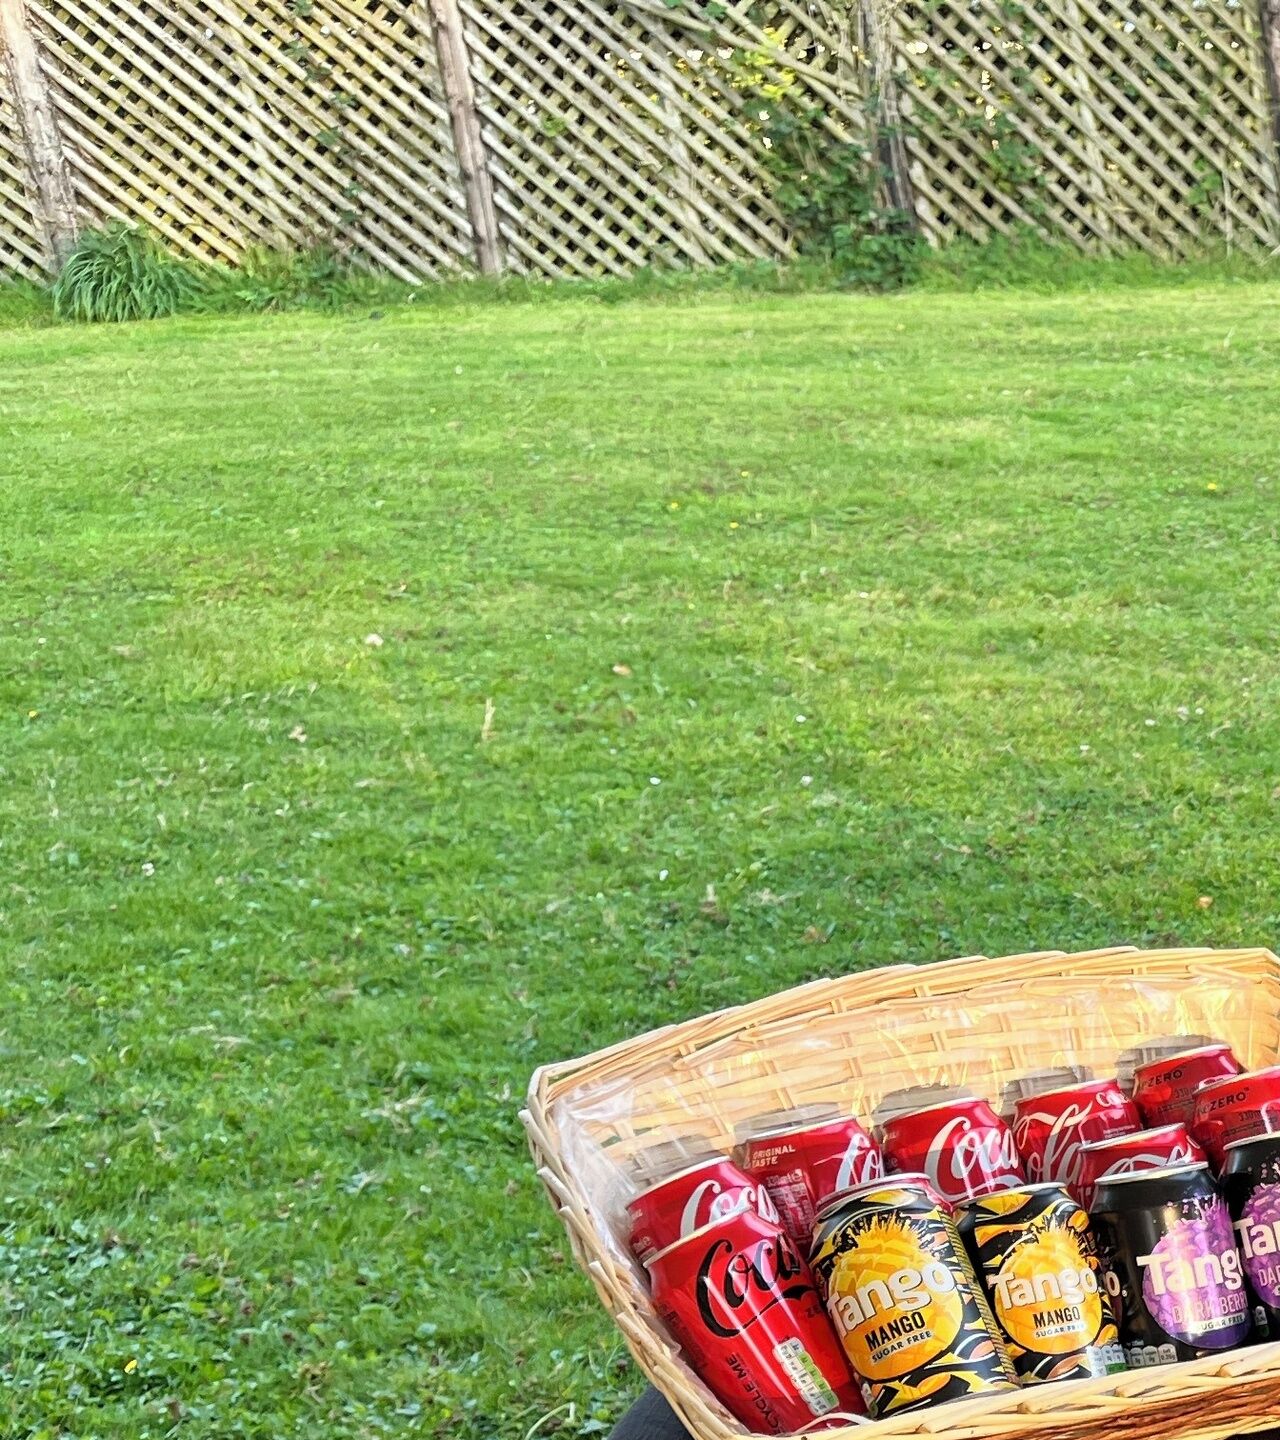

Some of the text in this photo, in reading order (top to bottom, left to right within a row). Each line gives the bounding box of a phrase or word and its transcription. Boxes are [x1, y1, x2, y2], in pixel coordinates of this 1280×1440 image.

[1148, 1069, 1183, 1087] ZERO
[1210, 1091, 1248, 1110] ZERO
[752, 1143, 796, 1161] ORIGINAL
[752, 1155, 778, 1168] TASTE
[1136, 1247, 1244, 1296] Tang
[826, 1261, 956, 1338] Tango
[985, 1268, 1099, 1311] Tango
[1032, 1306, 1081, 1329] MANGO
[865, 1311, 926, 1352] MANGO
[1035, 1326, 1064, 1338] SUGAR
[871, 1330, 933, 1364] SUGAR FREE
